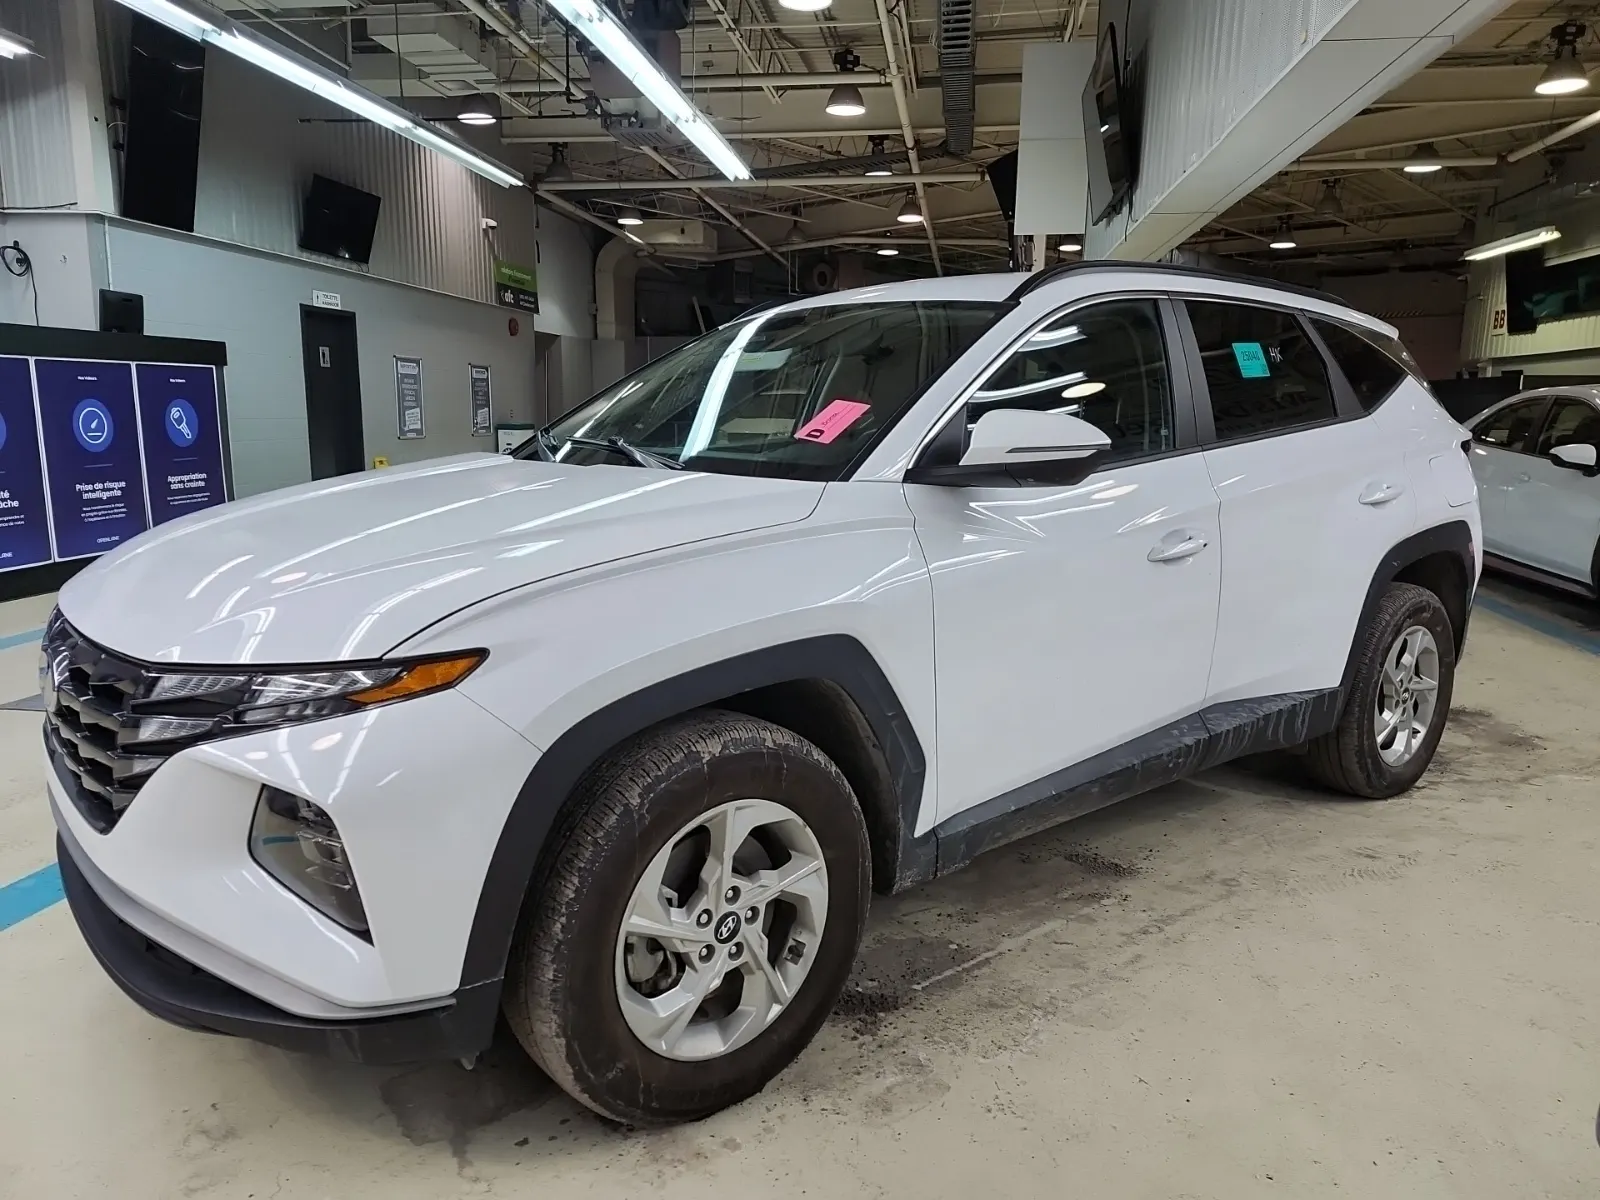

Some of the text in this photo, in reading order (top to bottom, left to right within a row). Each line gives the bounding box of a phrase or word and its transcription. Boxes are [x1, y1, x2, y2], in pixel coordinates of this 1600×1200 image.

[167, 472, 207, 483] Appropriation
[75, 481, 126, 492] Prise de risque
[170, 482, 184, 490] sans
[0, 489, 10, 499] té
[82, 489, 122, 500] intelligente
